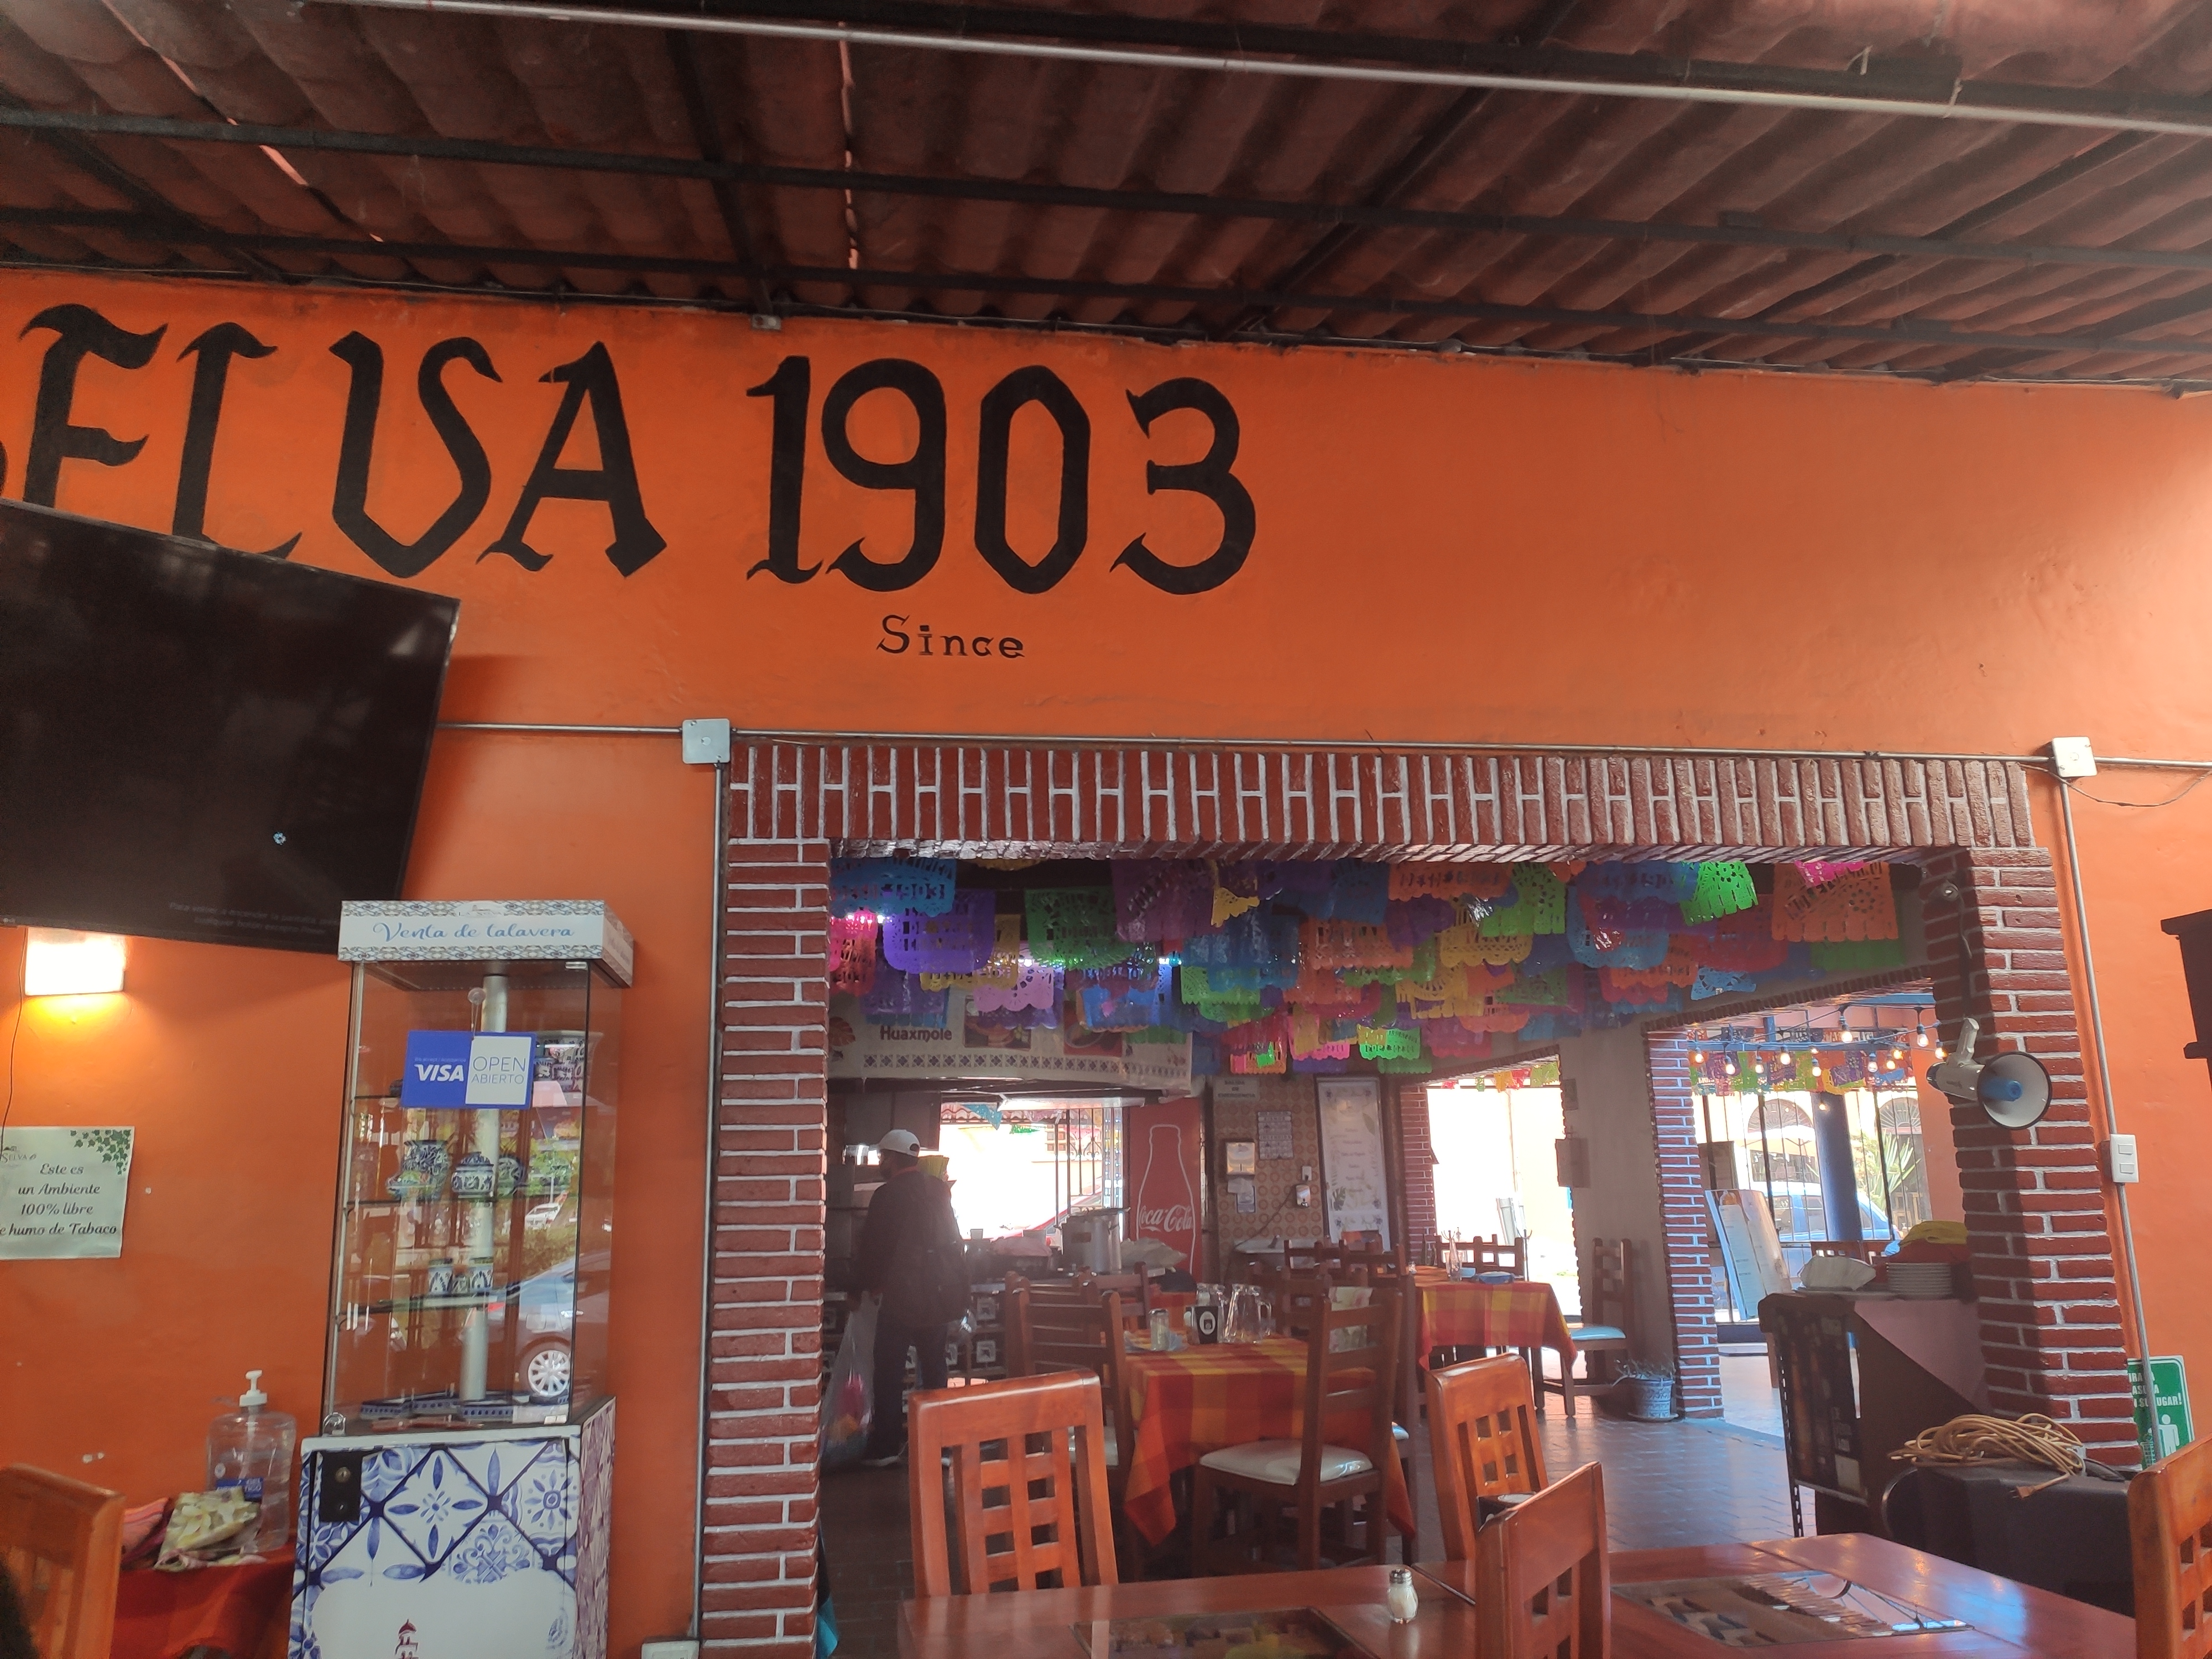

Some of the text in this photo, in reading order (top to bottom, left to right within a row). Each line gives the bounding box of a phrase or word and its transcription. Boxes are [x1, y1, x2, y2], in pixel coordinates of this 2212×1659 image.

[0, 303, 1256, 595] ELVA 1903
[877, 614, 1025, 659] Since
[372, 922, 447, 942] Venta
[453, 924, 480, 938] de
[880, 1025, 952, 1043] Huaxmole
[473, 1056, 526, 1072] OPEN
[414, 1064, 465, 1082] VISA
[471, 1073, 525, 1084] ABIERTO
[39, 1162, 84, 1175] Este es
[18, 1182, 101, 1195] un Ambiente
[21, 1201, 95, 1215] 100% libre
[8, 1222, 45, 1236] humo
[49, 1222, 65, 1235] de
[69, 1221, 117, 1235] Tabaco
[2128, 1372, 2143, 1383] IRA
[2156, 1392, 2182, 1406] UGAR!
